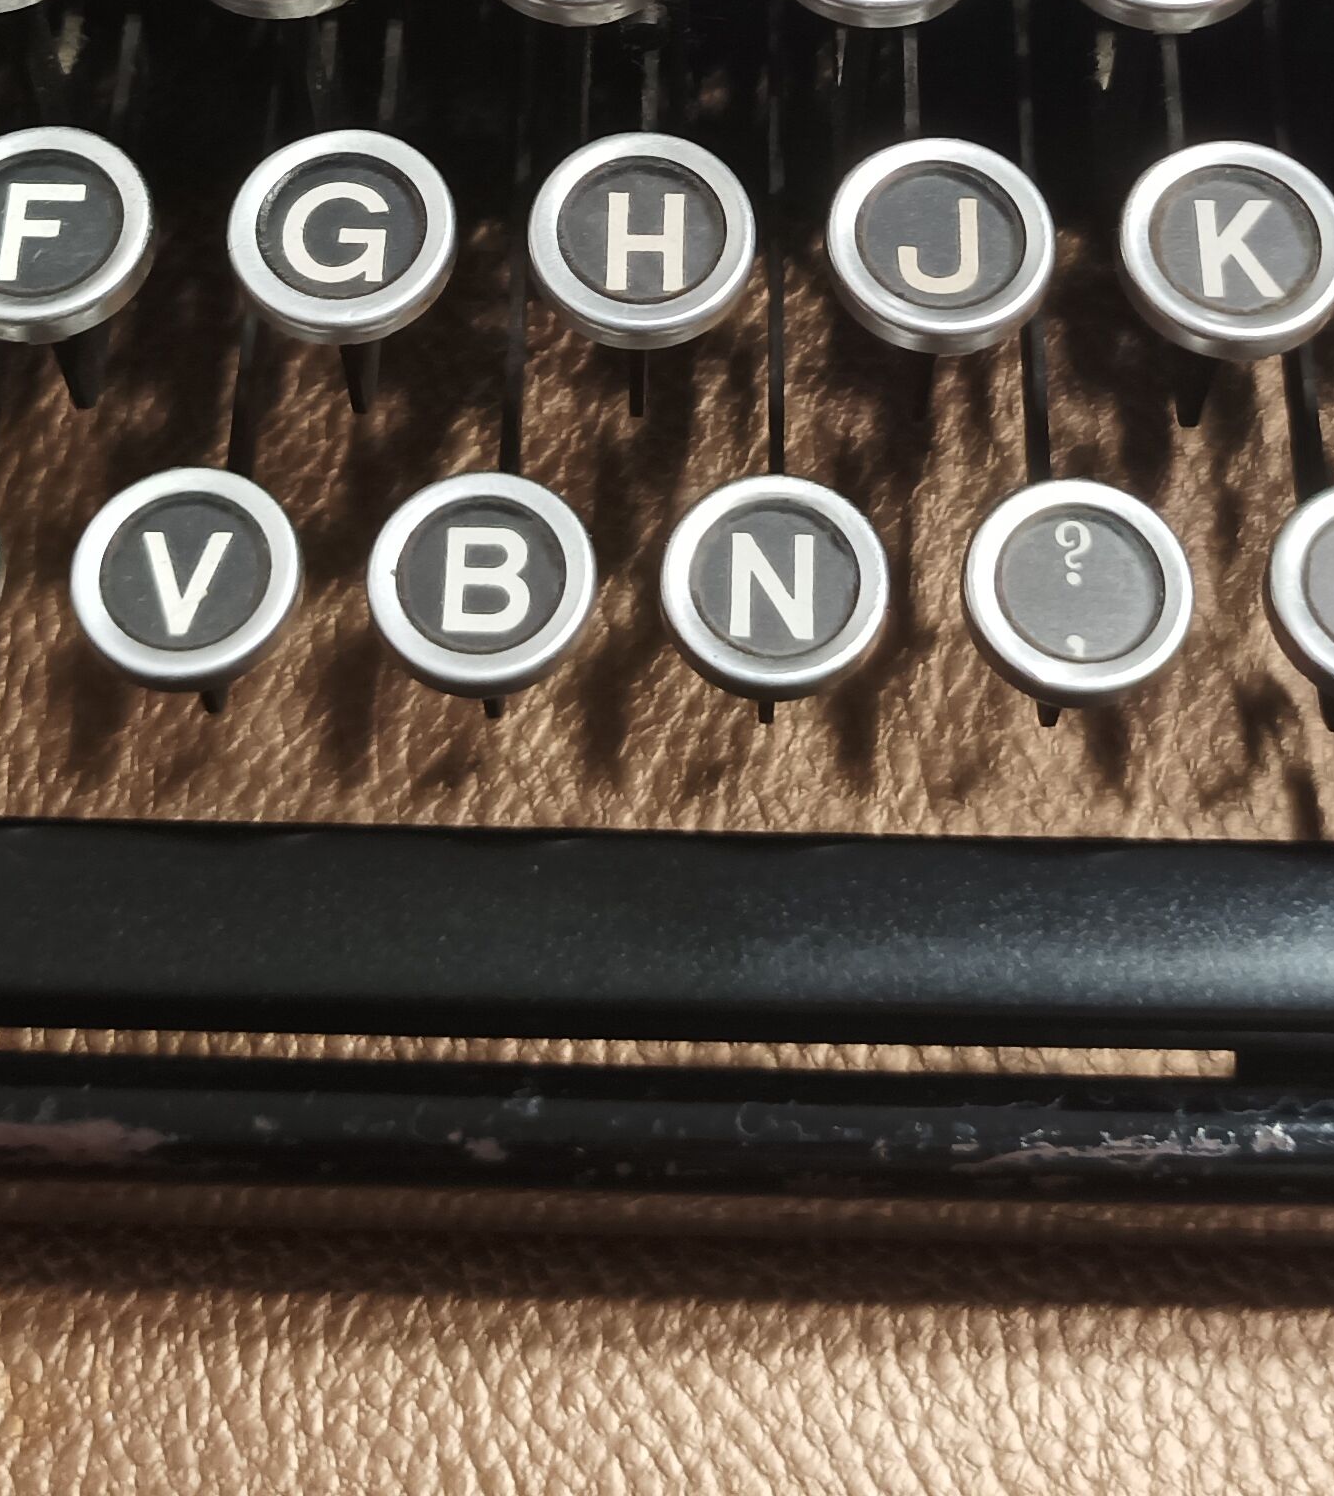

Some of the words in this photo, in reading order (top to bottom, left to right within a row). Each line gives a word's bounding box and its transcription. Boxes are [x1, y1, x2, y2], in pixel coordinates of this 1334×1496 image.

[282, 182, 390, 283] G
[604, 192, 686, 291] H
[898, 197, 979, 293] J
[1192, 199, 1280, 298] K
[143, 531, 233, 635] V
[442, 527, 529, 632] B
[729, 532, 814, 640] N
[1054, 519, 1092, 585] ?
